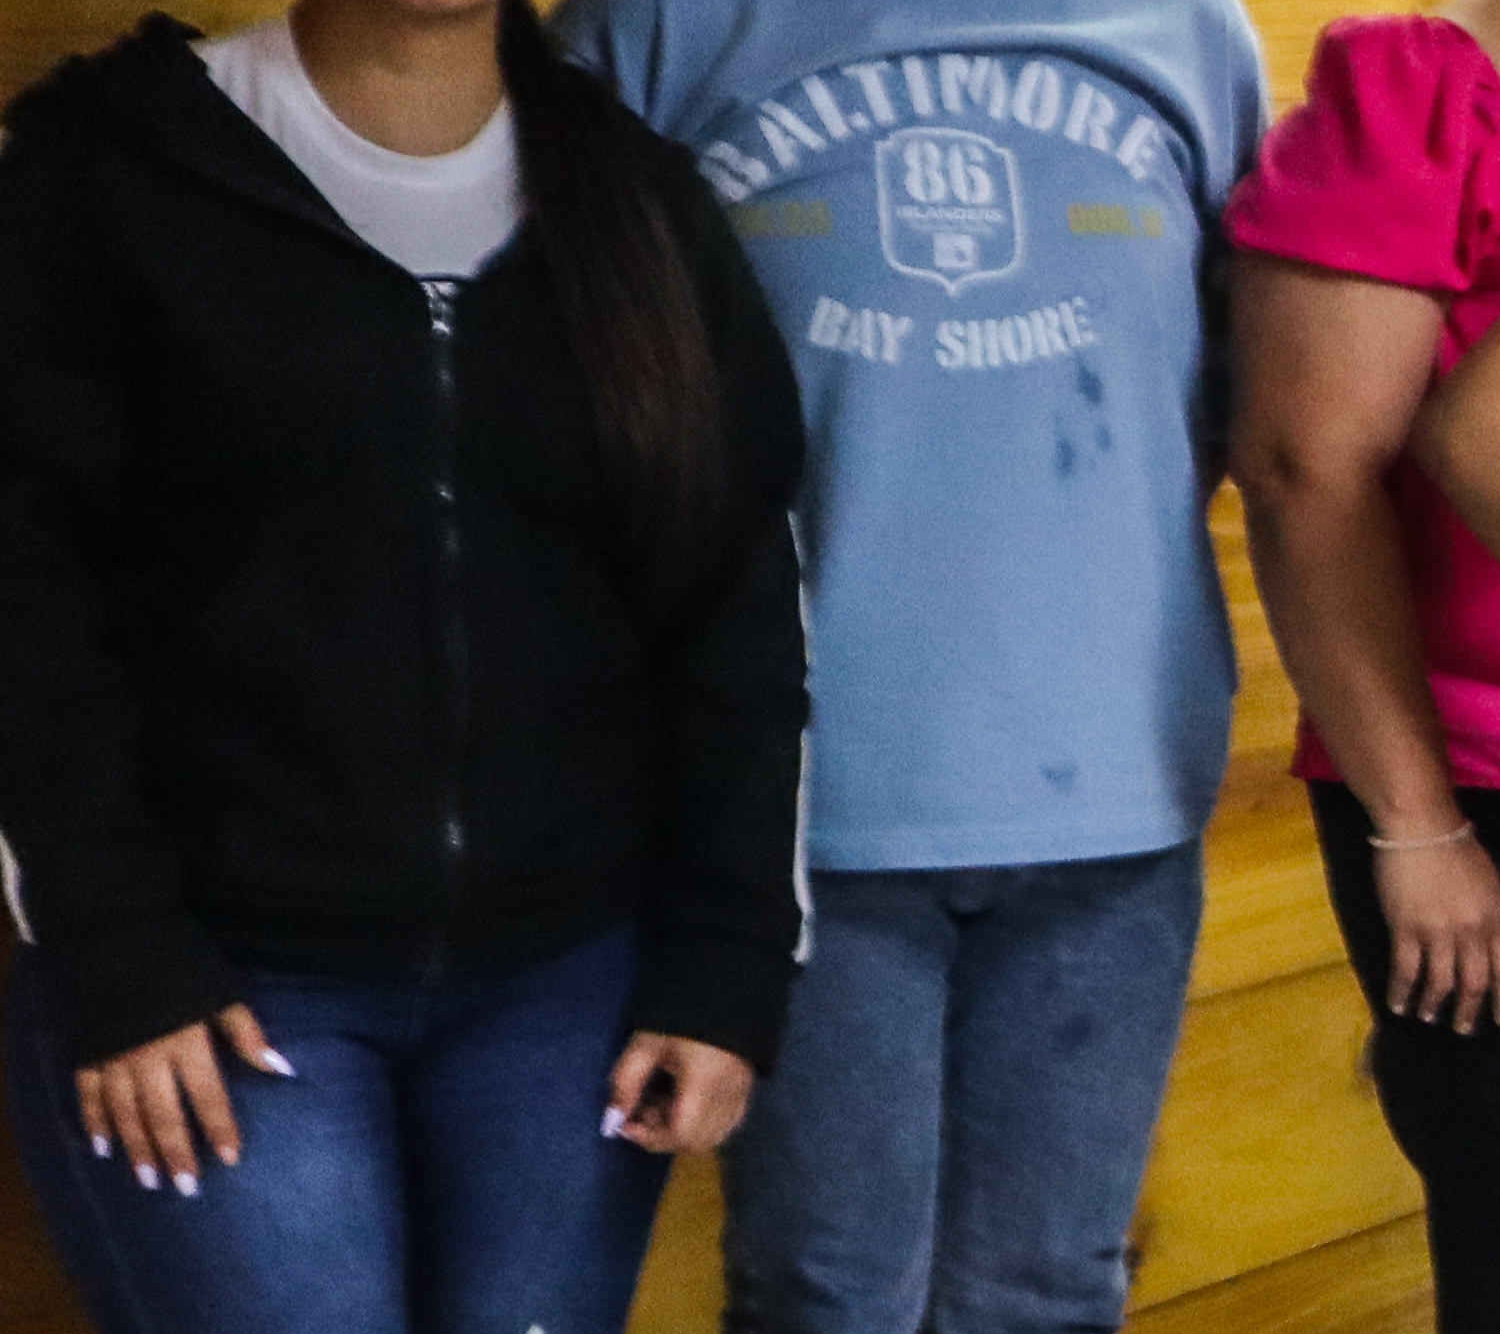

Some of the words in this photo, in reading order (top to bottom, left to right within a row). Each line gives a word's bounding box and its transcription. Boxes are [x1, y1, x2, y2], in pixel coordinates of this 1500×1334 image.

[698, 53, 1165, 203] BALTIMORE
[903, 138, 994, 204] 86
[808, 295, 914, 364] BAY
[934, 295, 1099, 369] SHORE
